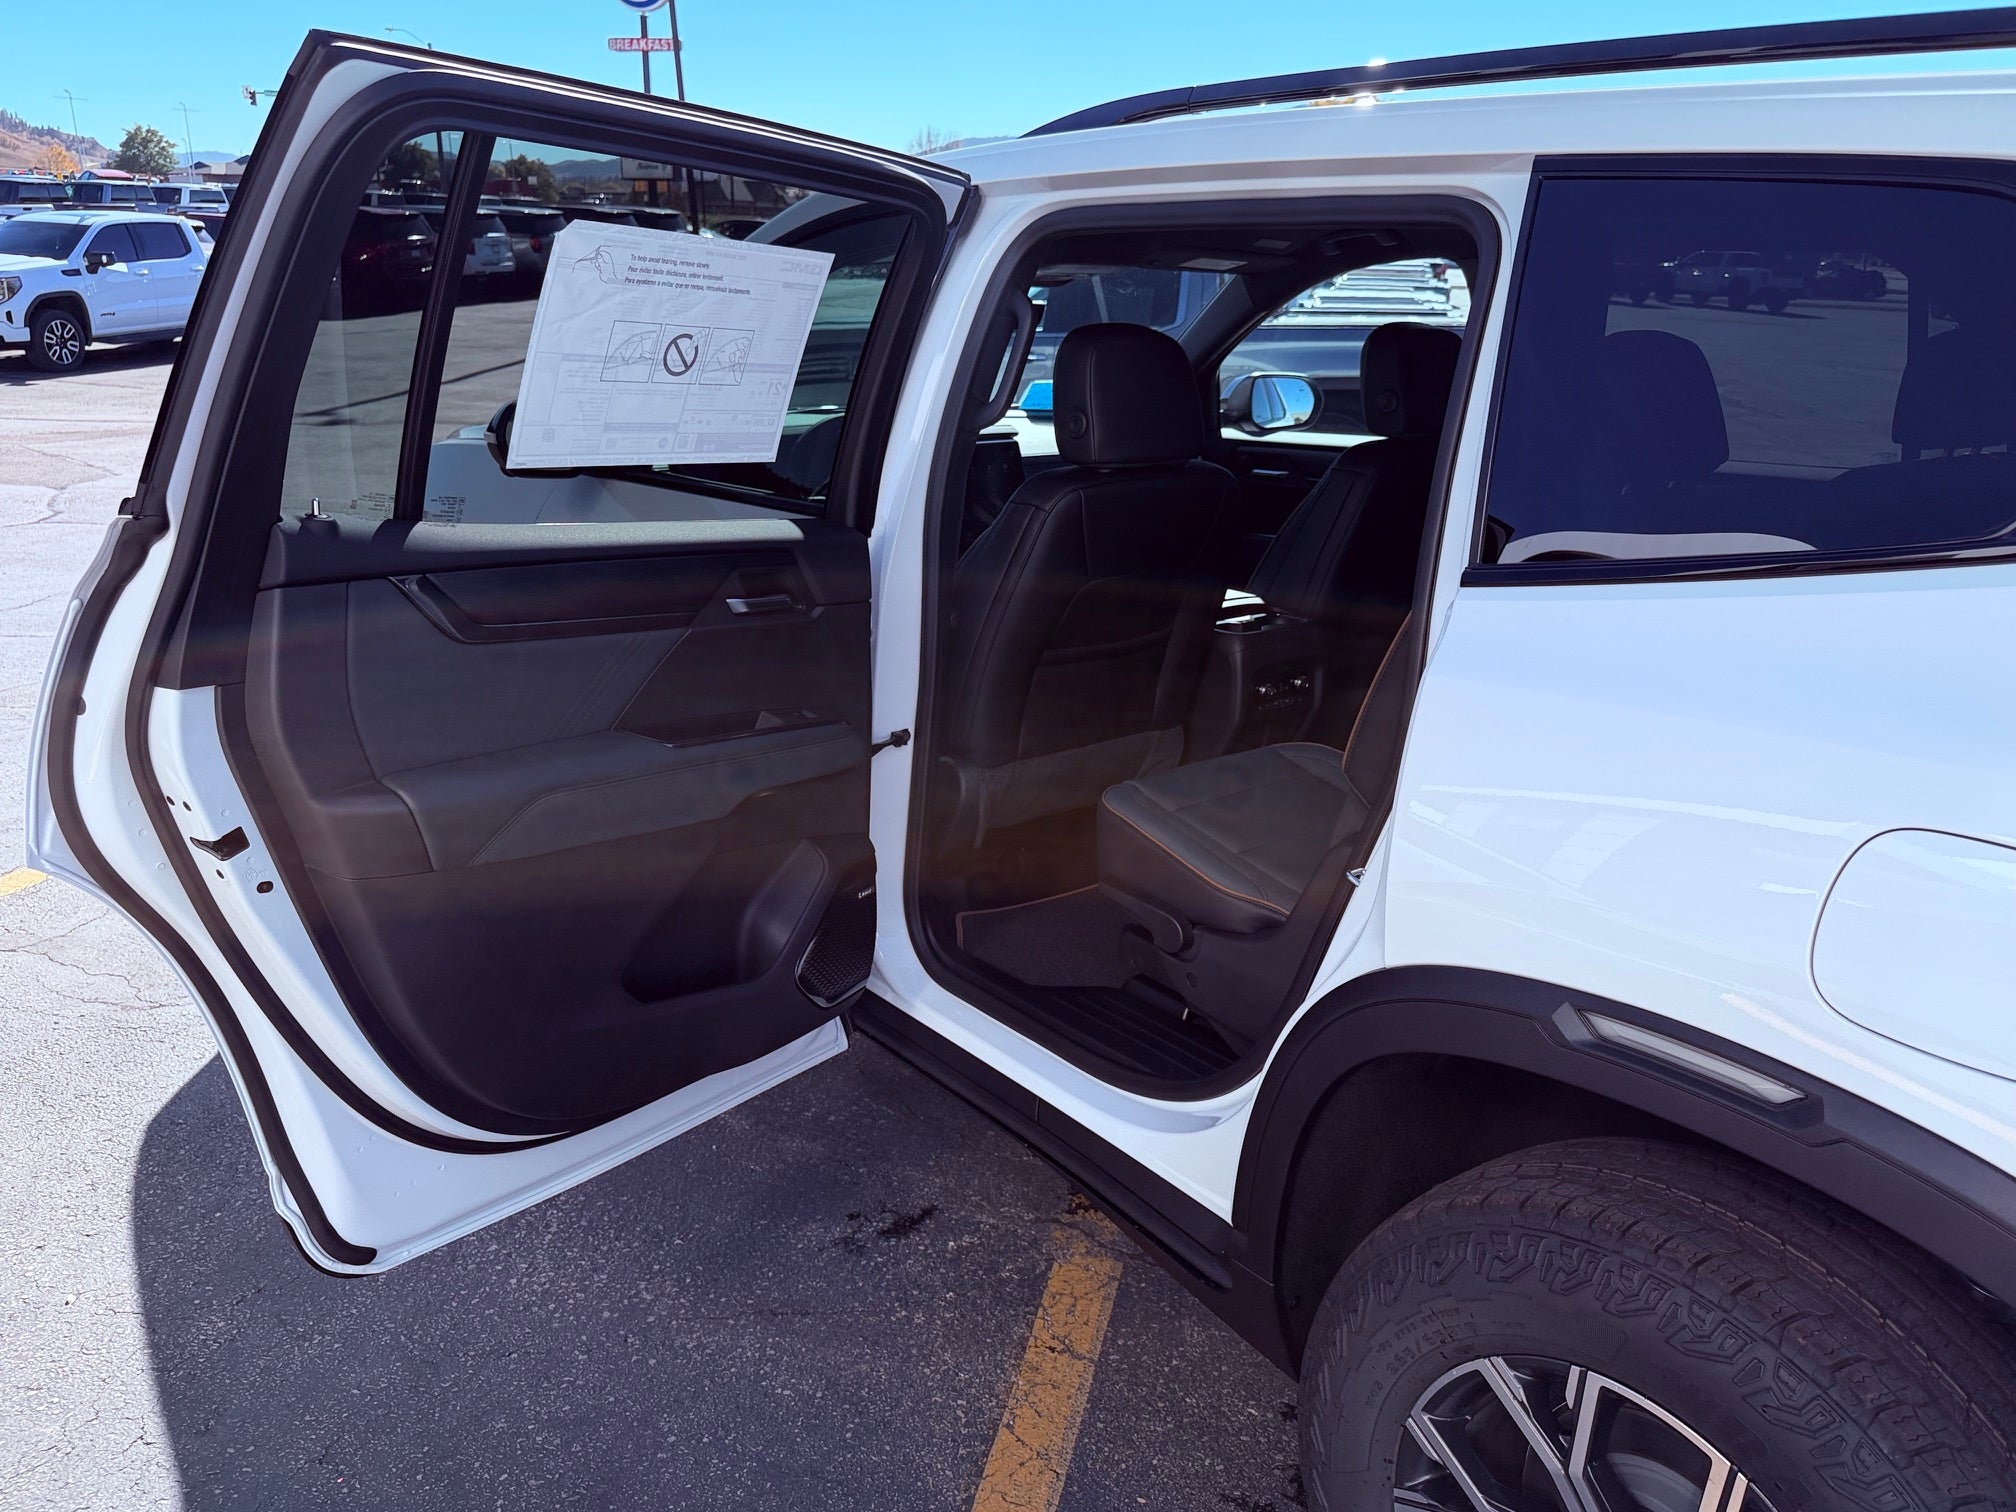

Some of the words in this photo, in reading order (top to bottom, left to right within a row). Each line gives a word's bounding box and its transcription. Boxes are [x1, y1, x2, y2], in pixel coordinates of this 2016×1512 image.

[609, 38, 674, 51] BREAKFAST
[631, 253, 637, 261] To
[637, 254, 648, 263] help
[661, 257, 678, 267] tearing,
[627, 265, 639, 273] Pour
[688, 271, 702, 279] retirer
[624, 276, 635, 284] Para
